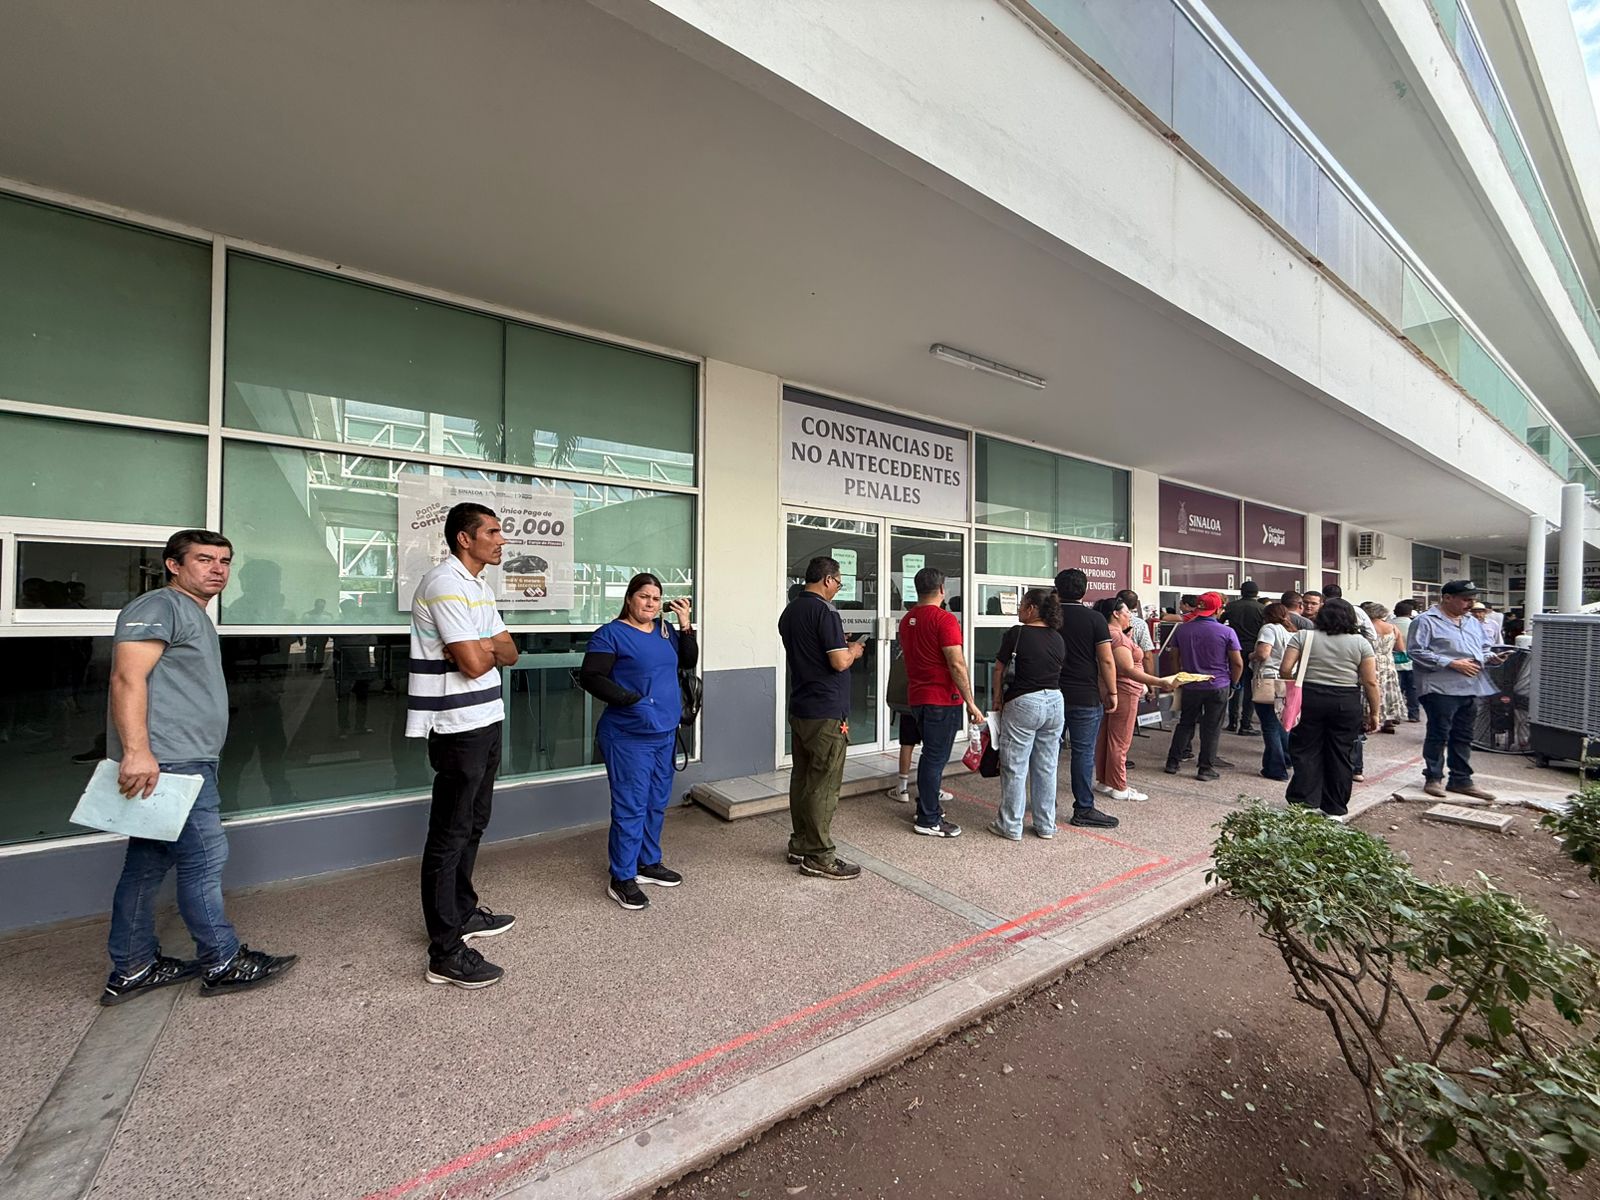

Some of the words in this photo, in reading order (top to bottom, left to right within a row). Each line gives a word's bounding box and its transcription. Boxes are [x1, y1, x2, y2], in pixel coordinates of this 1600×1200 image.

[801, 416, 930, 458] CONSTANCIAS
[934, 443, 954, 462] DE
[791, 441, 822, 463] NO
[827, 449, 961, 487] ANTECEDENTES
[844, 477, 921, 504] PENALES
[500, 505, 522, 515] Único
[523, 509, 542, 517] Pago
[411, 514, 446, 530] Corrie
[500, 516, 564, 536] 6,000
[1188, 514, 1221, 531] SINALOA
[1268, 533, 1285, 547] Digital
[1081, 555, 1109, 566] NUESTRO
[1074, 567, 1116, 579] MPROMISO
[1086, 581, 1116, 591] TENDERTE
